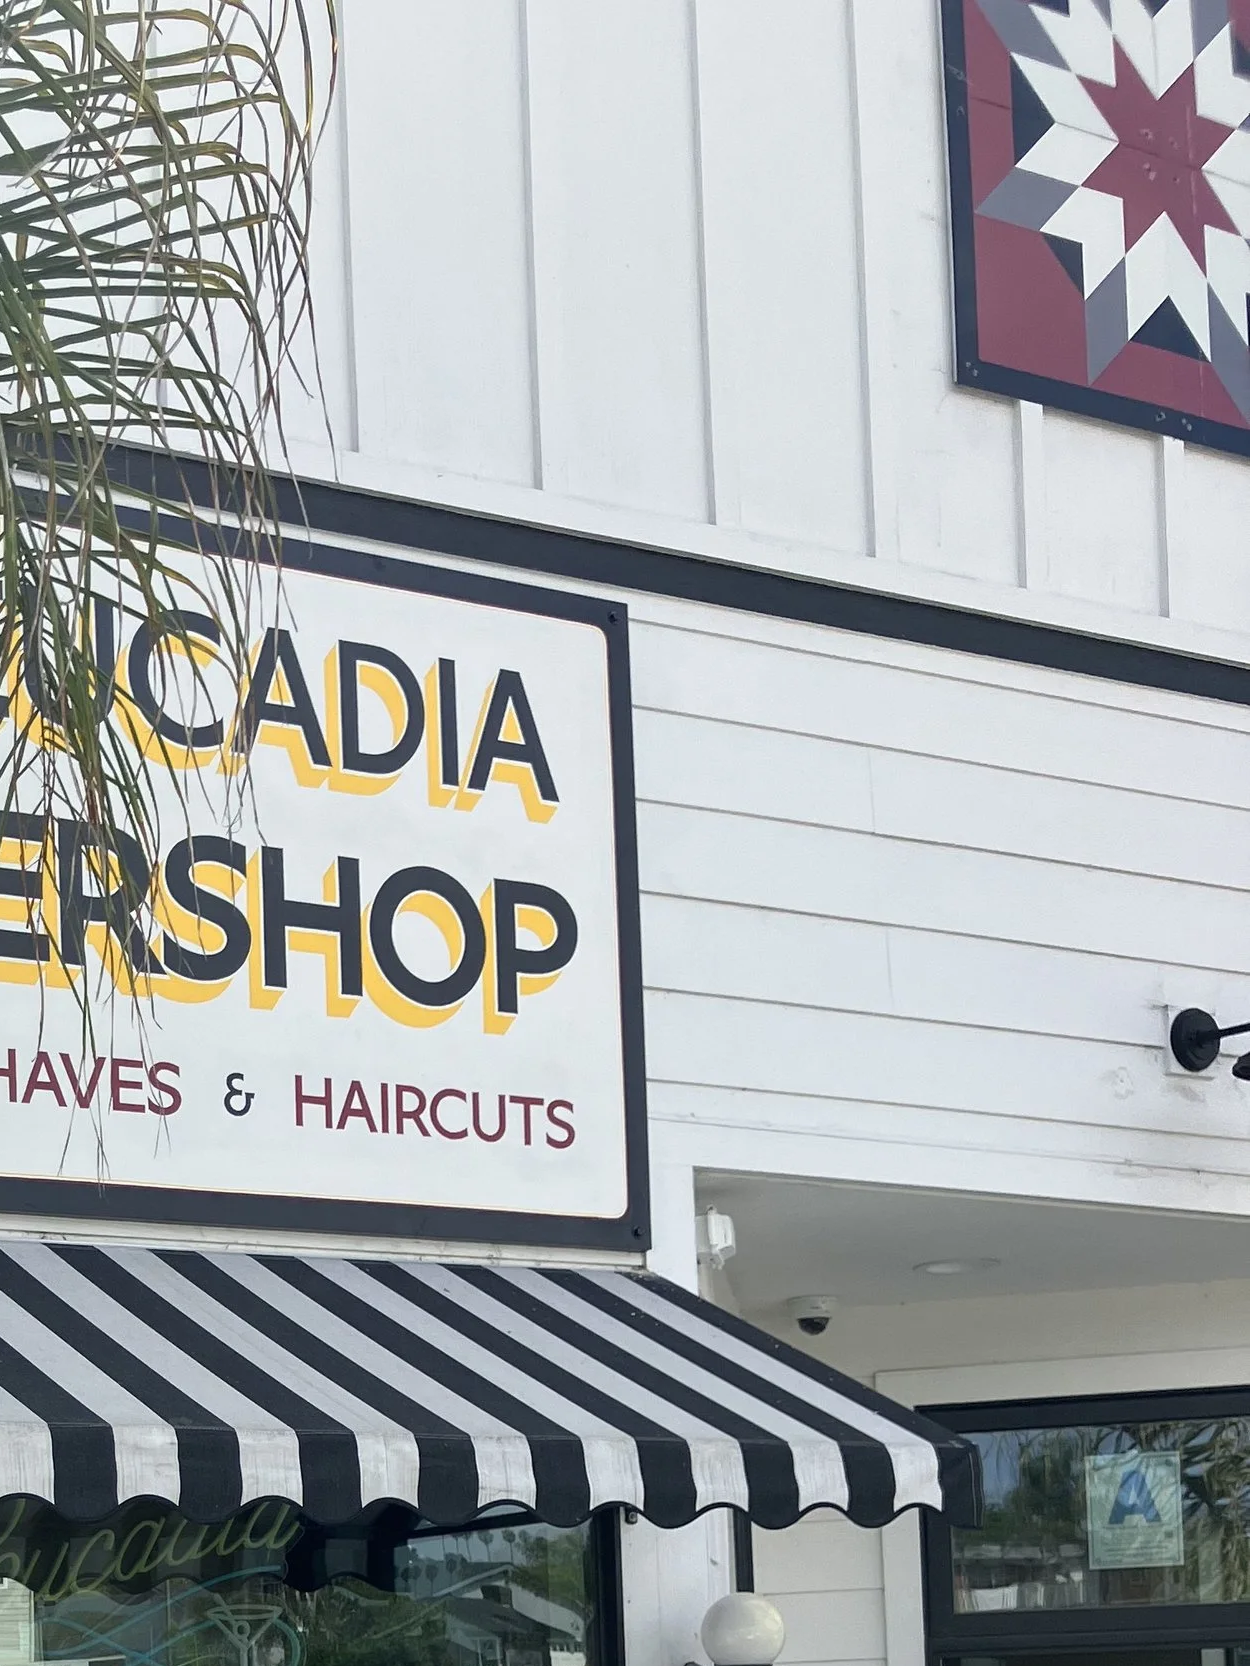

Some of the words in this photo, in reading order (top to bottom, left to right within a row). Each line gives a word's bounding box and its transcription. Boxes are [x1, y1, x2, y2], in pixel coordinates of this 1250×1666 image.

[224, 1072, 254, 1117] &
[294, 1075, 577, 1150] HAIRCUTS
[1108, 1470, 1162, 1525] A
